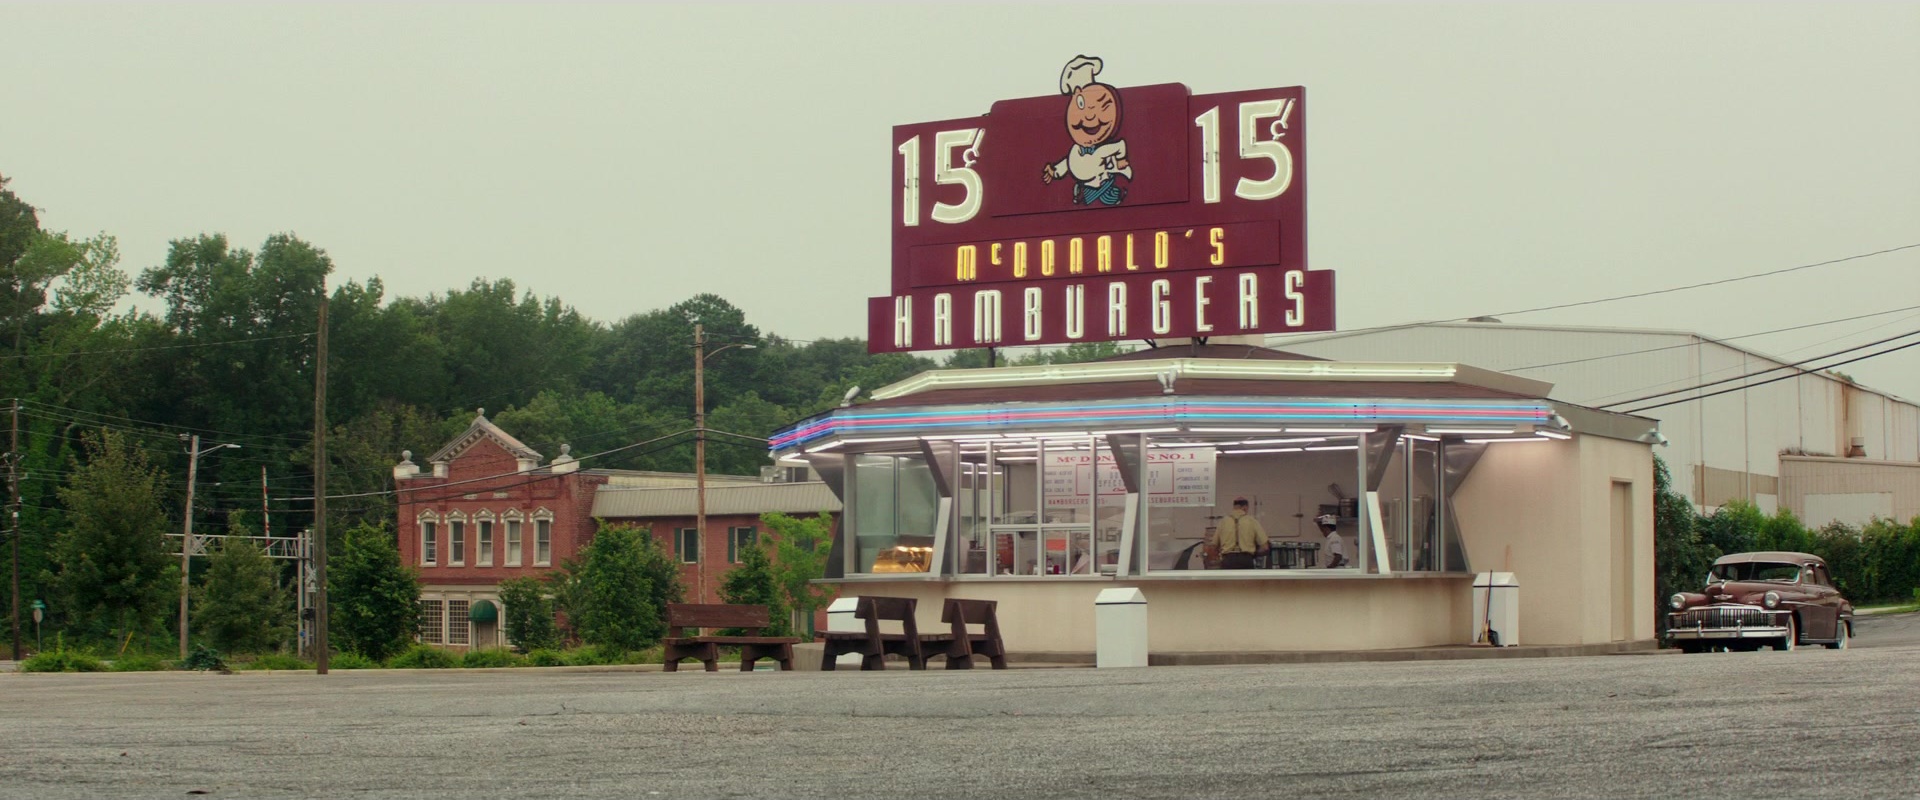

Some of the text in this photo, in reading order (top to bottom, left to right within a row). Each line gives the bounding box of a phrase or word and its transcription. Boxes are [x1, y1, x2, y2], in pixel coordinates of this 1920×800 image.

[898, 127, 986, 227] 15¢
[1195, 98, 1296, 204] 15¢
[894, 270, 1305, 348] HAMBURGERS
